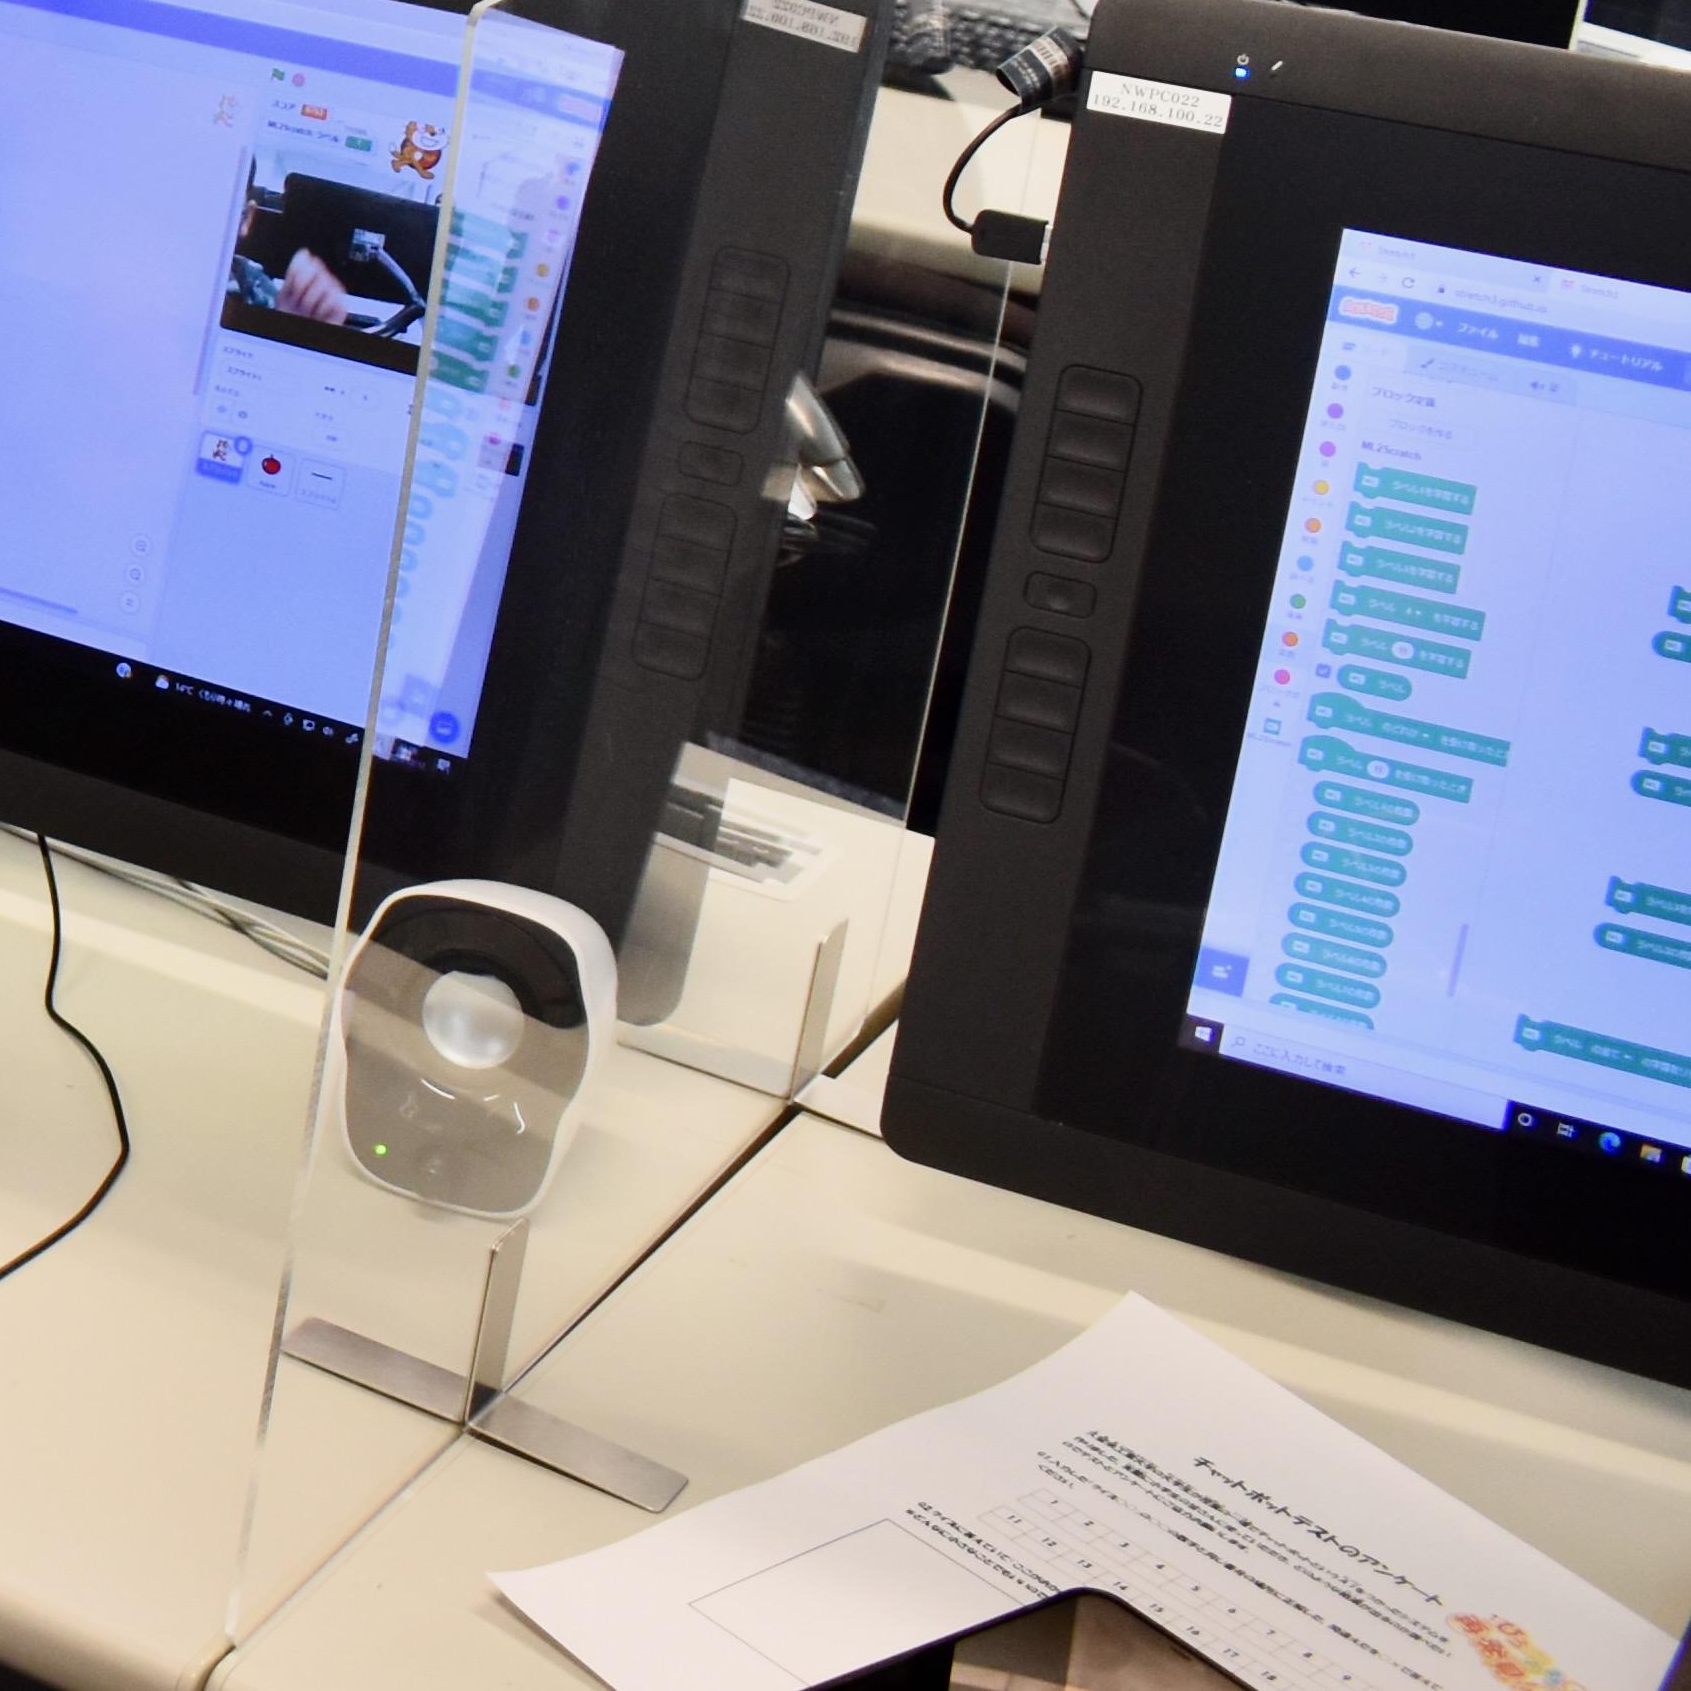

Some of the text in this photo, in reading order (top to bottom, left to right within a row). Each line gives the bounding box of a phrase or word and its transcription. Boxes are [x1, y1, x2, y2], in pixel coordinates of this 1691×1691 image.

[1093, 94, 1223, 127] 192.168.100.22
[1121, 83, 1200, 108] NWPC022
[1458, 322, 1499, 340] ファイル
[1589, 348, 1664, 372] チュートリアル
[1373, 386, 1436, 409] ブロック定義
[1362, 441, 1421, 461] ML2Scratch
[1253, 1042, 1345, 1074] ここに入力して検索
[1193, 1455, 1444, 1607] チャットボットテストのアンケート
[1007, 1514, 1278, 1681] 11 12 13 14 15 16 17 18
